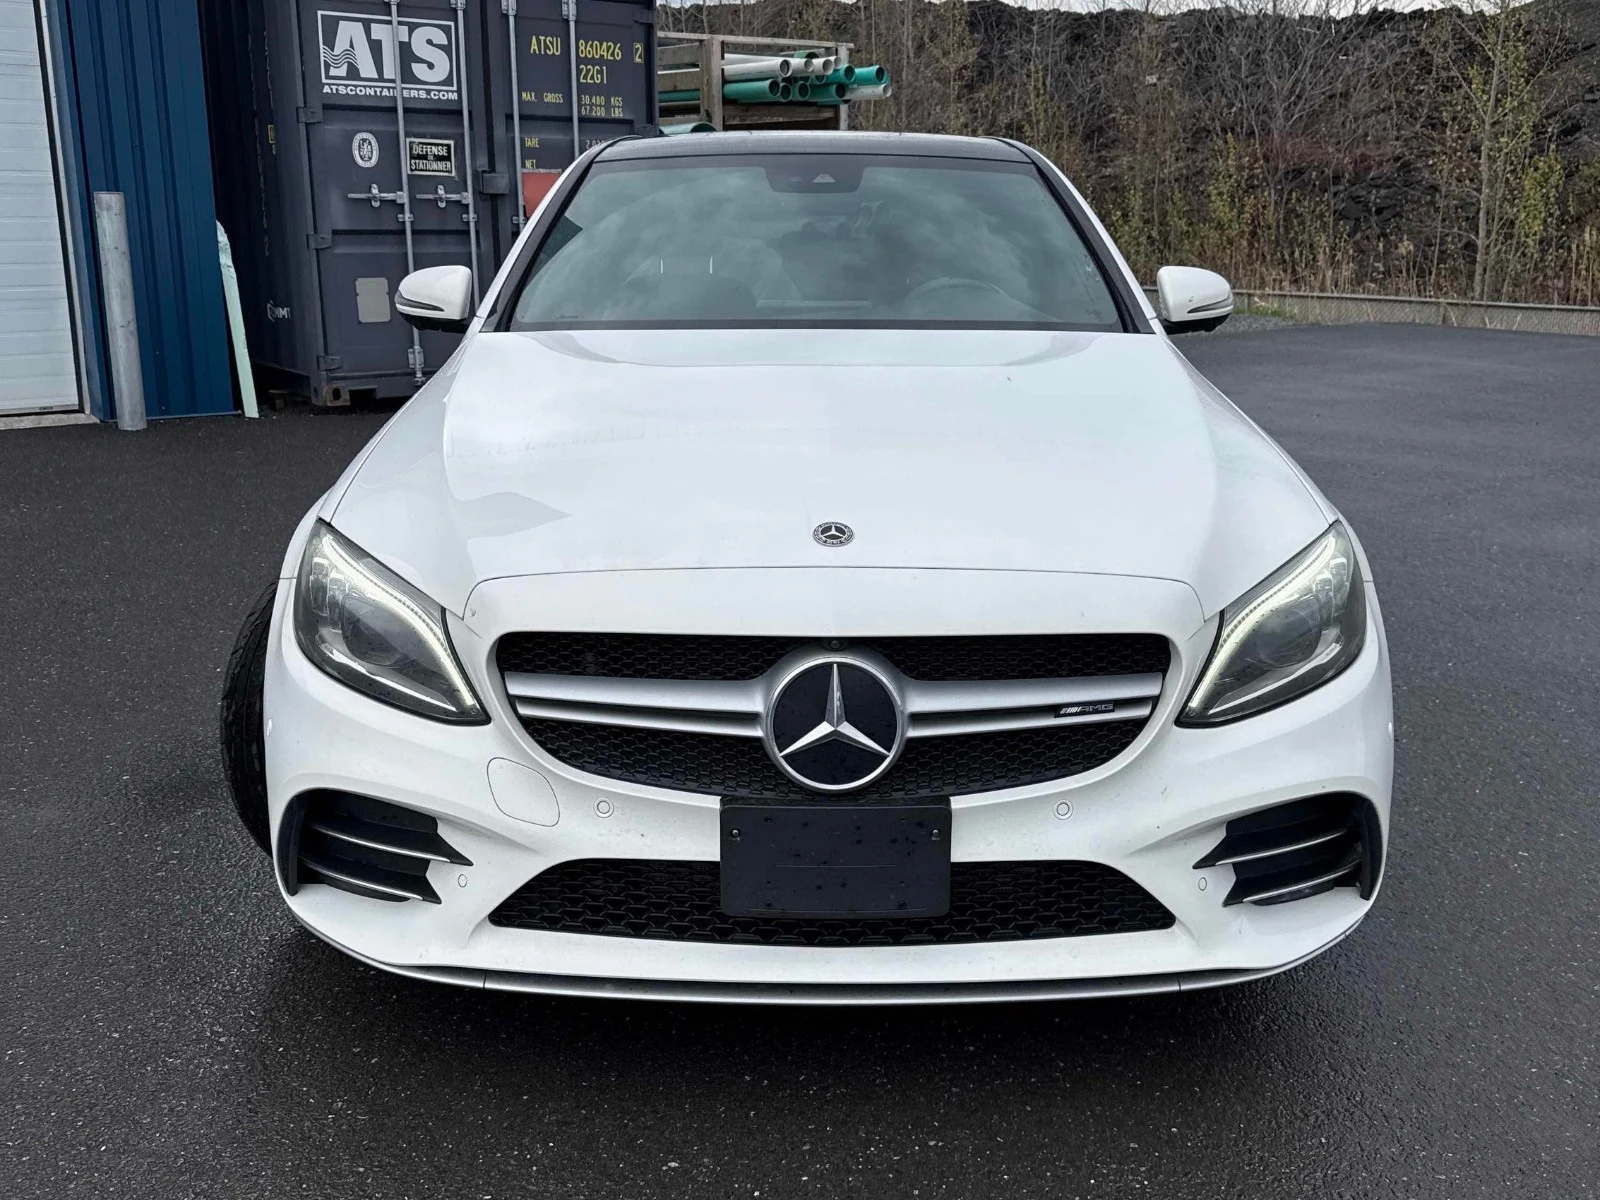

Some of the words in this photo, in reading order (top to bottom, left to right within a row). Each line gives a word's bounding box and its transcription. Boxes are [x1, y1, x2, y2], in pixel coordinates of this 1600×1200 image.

[328, 20, 451, 83] ATS
[530, 35, 561, 56] ATSU
[578, 40, 622, 61] 860426
[634, 44, 642, 62] 2
[579, 65, 607, 84] 22G1
[521, 91, 537, 102] MAX.
[543, 93, 563, 104] GROSS
[581, 95, 605, 106] 30.480
[610, 96, 623, 106] KGS
[611, 107, 624, 117] LBS
[524, 137, 539, 148] TARE
[410, 159, 451, 171] STATIONNER
[525, 159, 537, 169] NET
